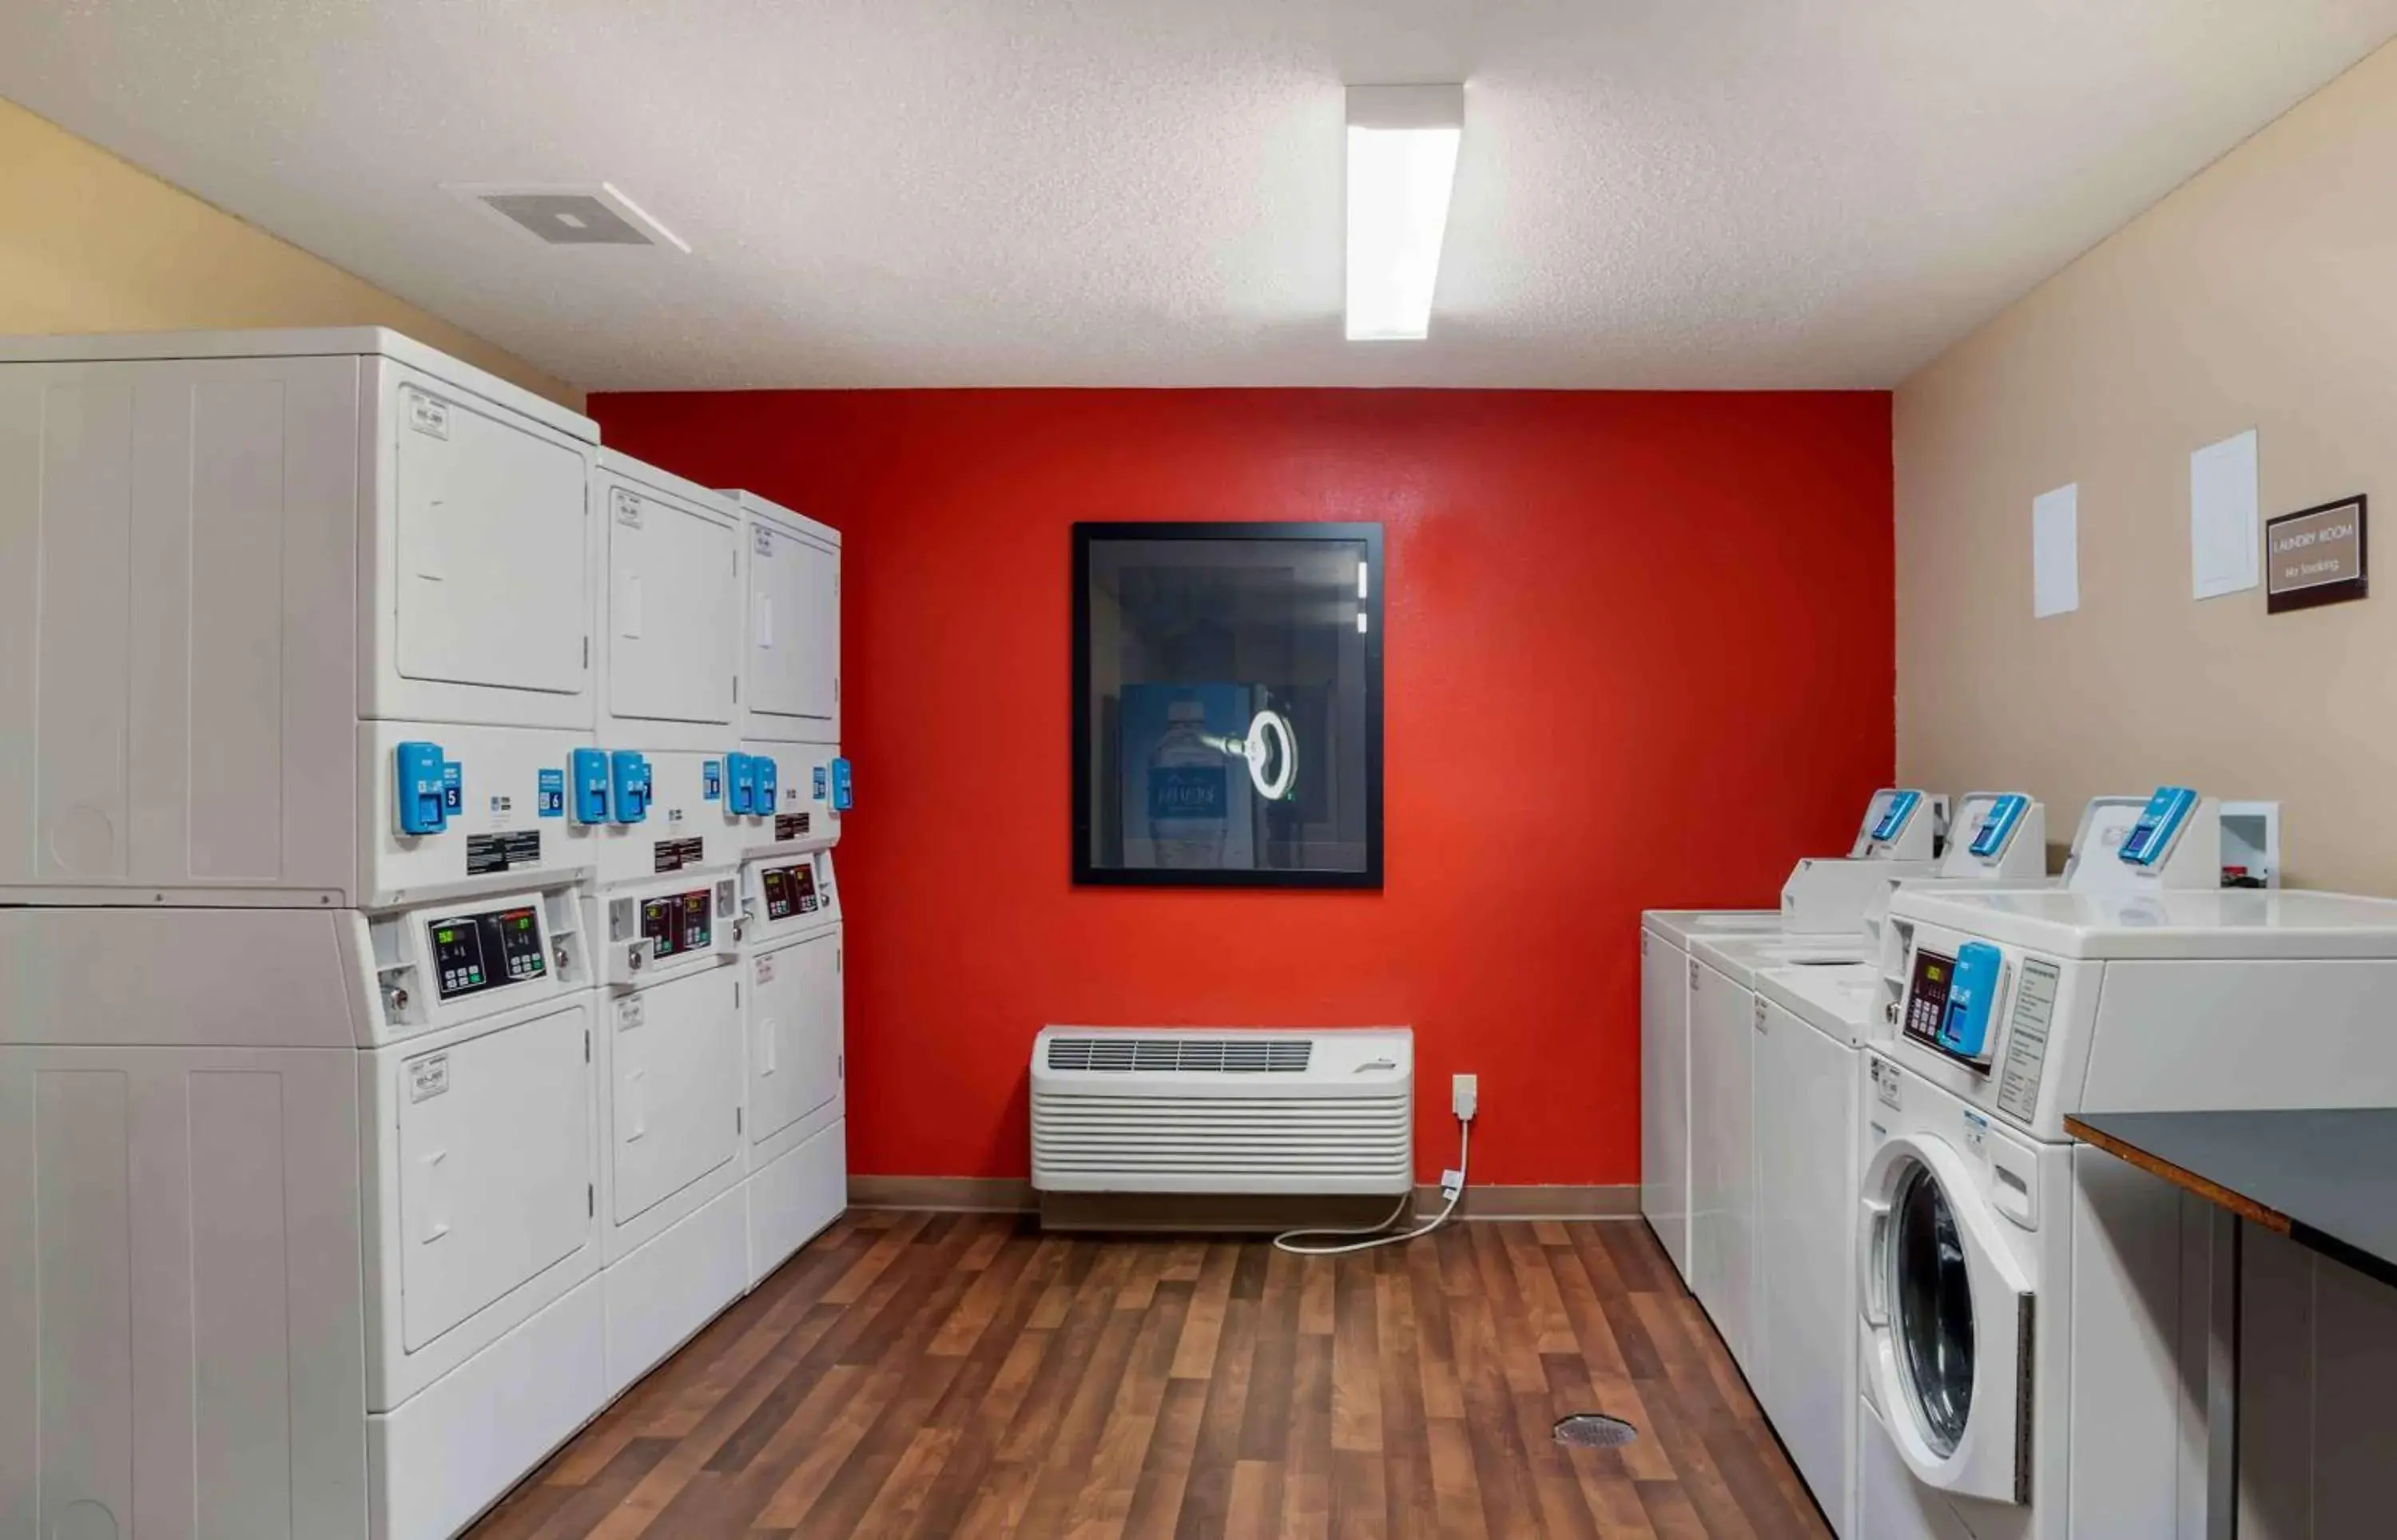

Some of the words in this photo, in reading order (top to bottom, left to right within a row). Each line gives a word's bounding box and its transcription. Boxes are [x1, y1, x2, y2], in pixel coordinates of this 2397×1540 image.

[2273, 533, 2316, 554] LAUNDRY
[2319, 524, 2353, 543] ROOM
[447, 790, 456, 806] 5
[552, 794, 559, 808] 6
